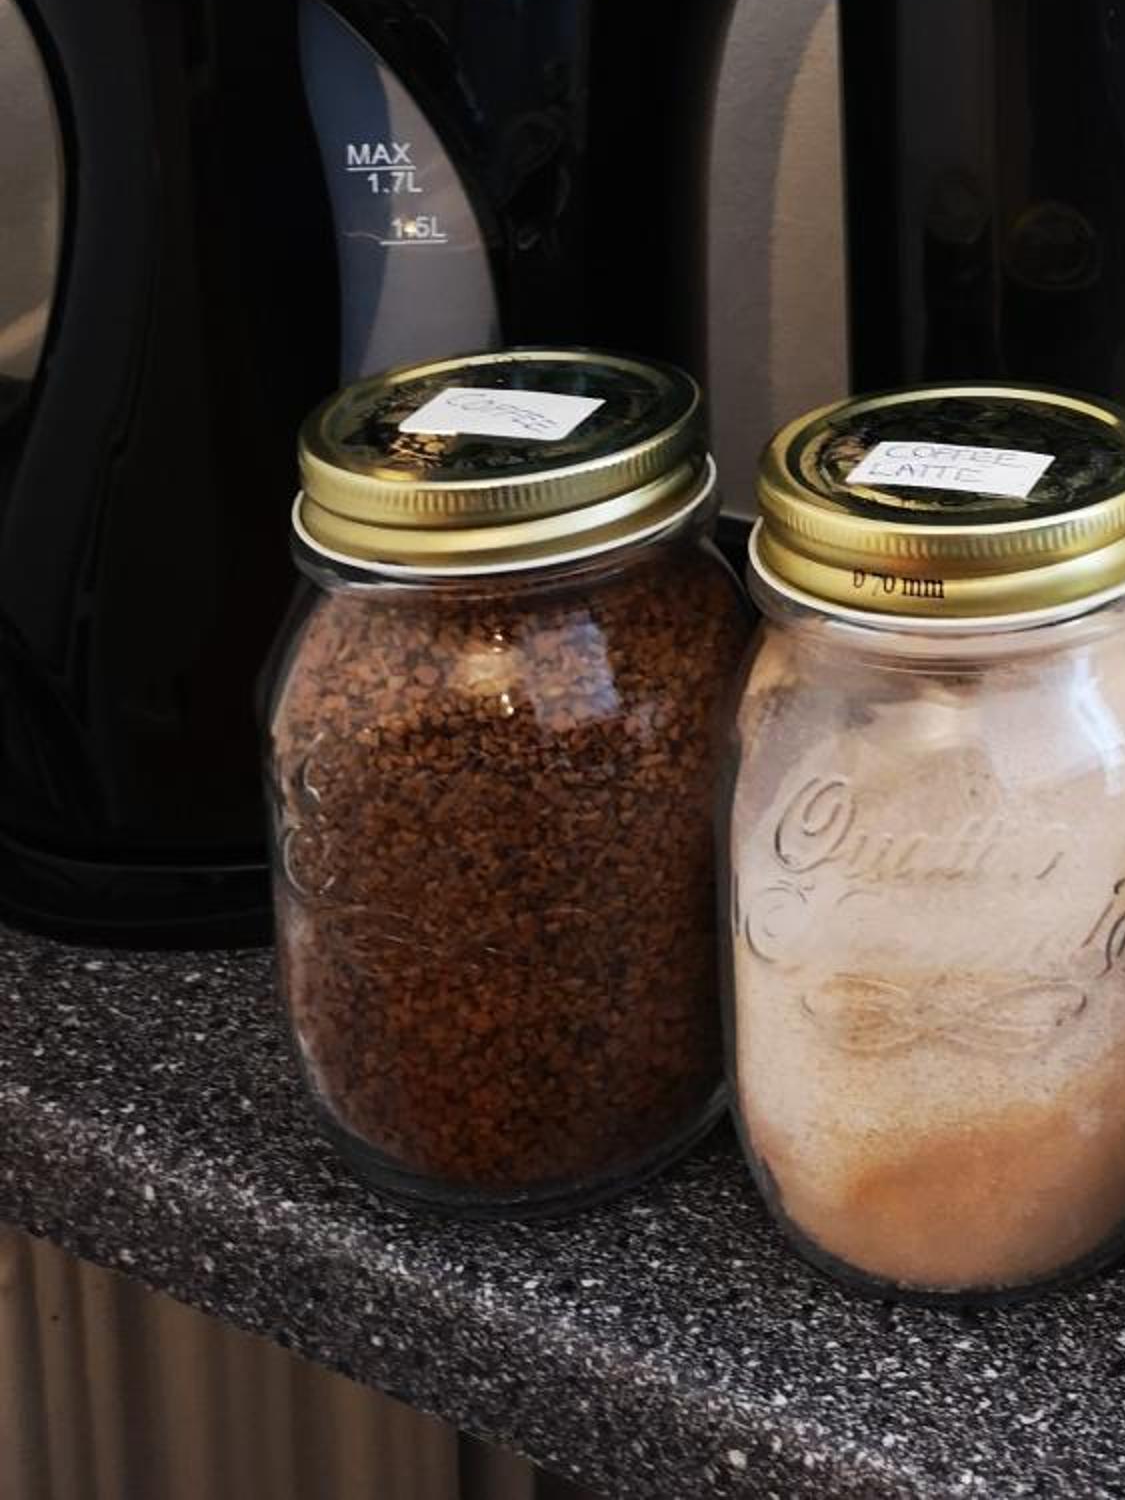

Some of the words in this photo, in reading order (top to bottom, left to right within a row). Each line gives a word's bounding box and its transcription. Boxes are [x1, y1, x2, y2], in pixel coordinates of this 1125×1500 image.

[346, 143, 412, 165] MAX
[367, 171, 423, 194] 1.7L
[884, 443, 1021, 468] COFFEE
[867, 461, 985, 483] LATTE
[902, 577, 945, 599] mm
